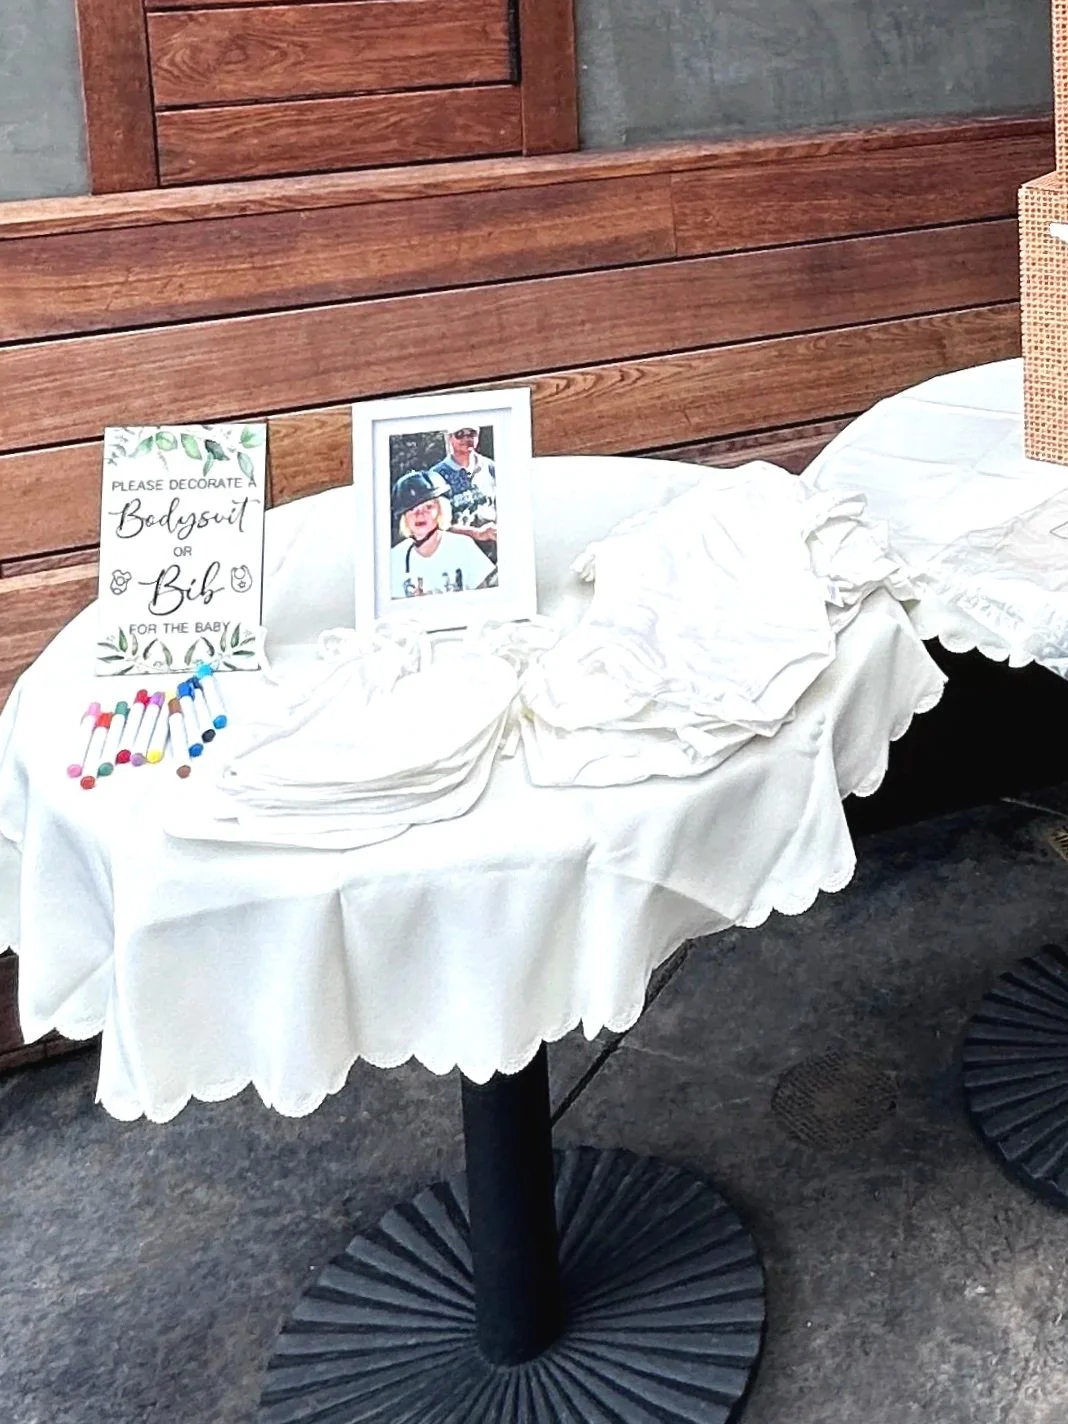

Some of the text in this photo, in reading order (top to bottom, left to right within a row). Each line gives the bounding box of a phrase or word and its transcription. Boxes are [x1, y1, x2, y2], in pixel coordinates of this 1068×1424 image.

[111, 477, 257, 492] PLEASE DECORATE A
[108, 496, 261, 541] Bodysuit
[173, 545, 193, 557] OR
[138, 561, 225, 616] Bib
[129, 621, 231, 635] FOR THE BABY
